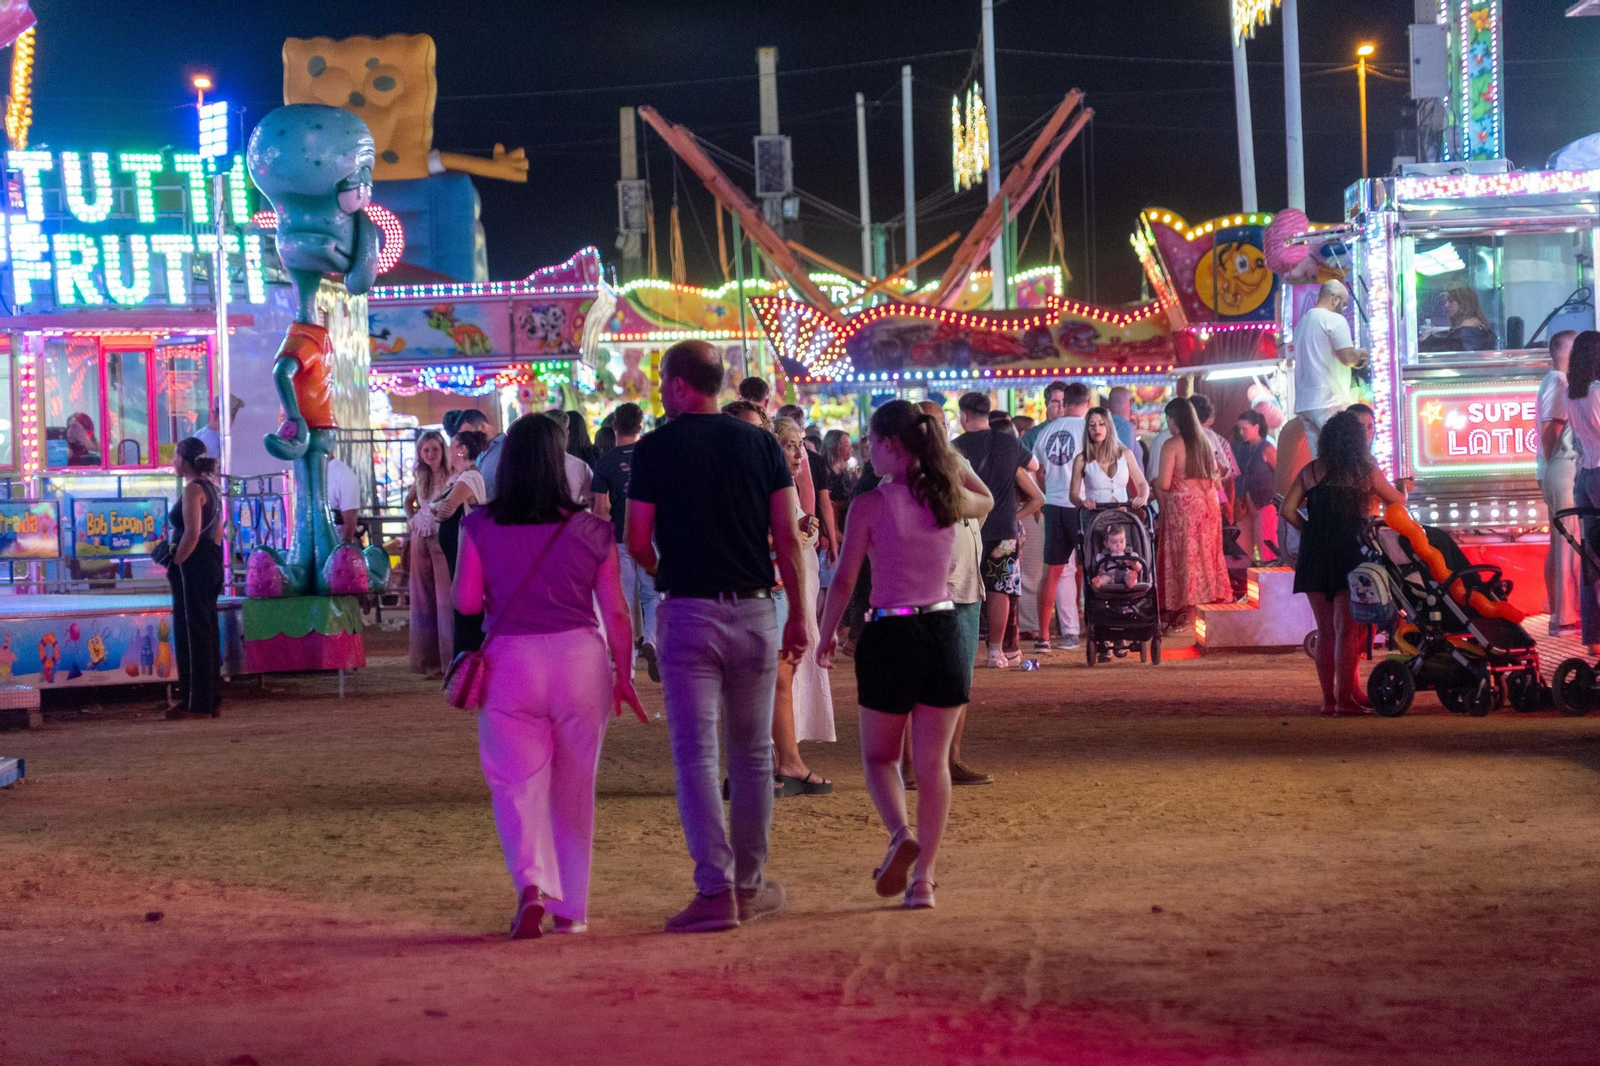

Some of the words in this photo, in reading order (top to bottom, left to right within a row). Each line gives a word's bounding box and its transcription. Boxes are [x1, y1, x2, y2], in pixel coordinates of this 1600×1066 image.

[7, 151, 250, 223] TUTTI
[9, 233, 266, 305] FRUTTI
[1048, 435, 1072, 457] AM
[86, 512, 108, 536] Bob
[110, 510, 154, 538] Esponja
